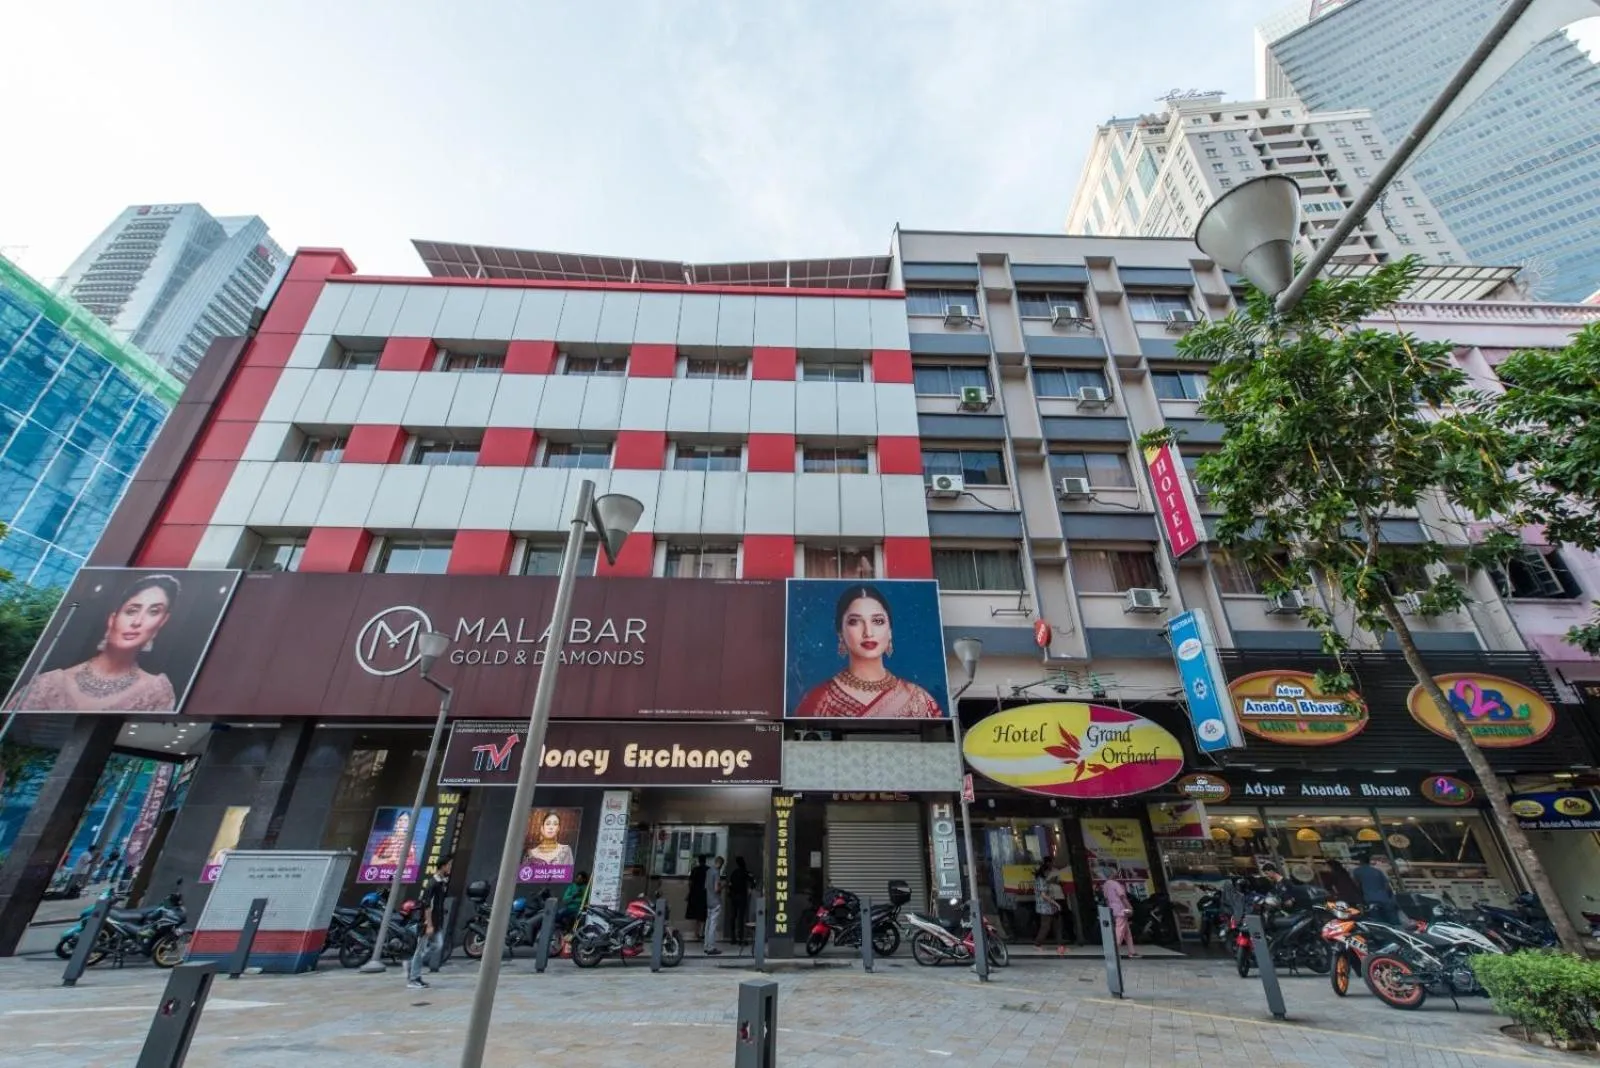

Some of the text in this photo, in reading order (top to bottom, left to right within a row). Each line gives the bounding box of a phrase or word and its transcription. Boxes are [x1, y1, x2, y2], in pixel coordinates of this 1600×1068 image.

[1156, 458, 1189, 546] HOTEL
[450, 650, 645, 666] GOLD & DAMONDS
[1278, 687, 1303, 697] Adyar
[1245, 700, 1344, 713] Ananda Bhava
[993, 723, 1134, 747] Hotel Grand
[539, 743, 752, 776] oney Exchange
[1101, 747, 1160, 765] Orchard
[1245, 782, 1411, 797] Adyar Ananda Bhavan
[933, 803, 957, 888] HOTEL
[775, 810, 791, 933] WESTERN UNION
